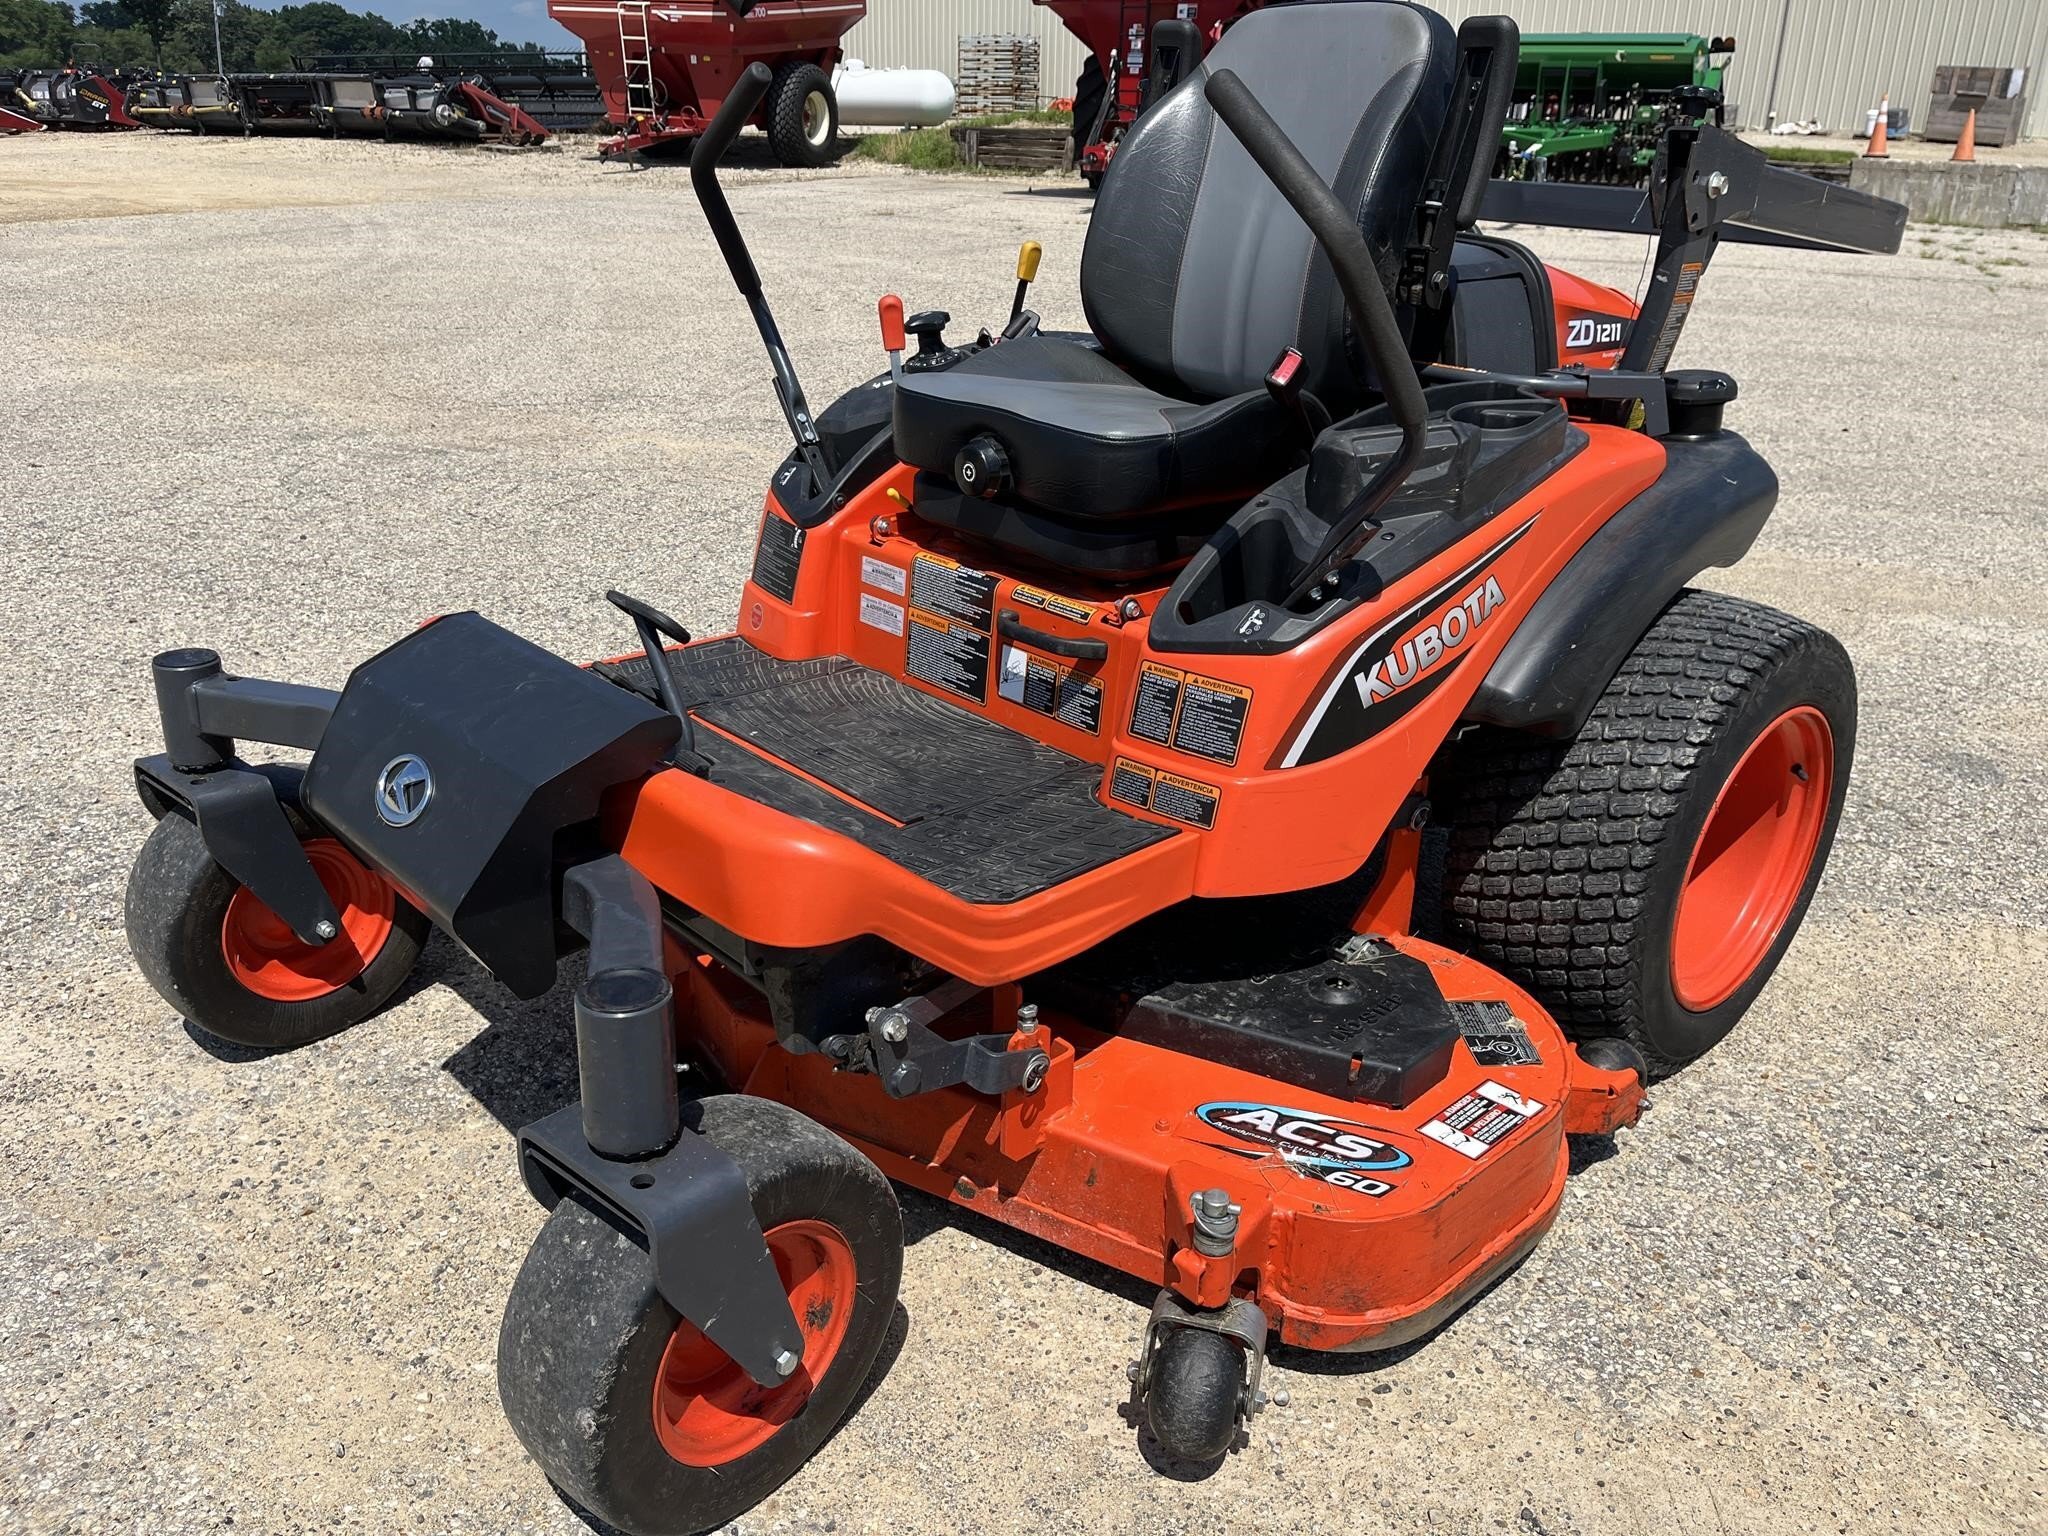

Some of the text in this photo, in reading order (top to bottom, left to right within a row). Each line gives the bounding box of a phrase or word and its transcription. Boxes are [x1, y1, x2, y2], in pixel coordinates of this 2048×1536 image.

[755, 8, 766, 17] 700
[79, 88, 109, 104] DRAGO
[91, 101, 107, 109] GT
[1566, 319, 1621, 347] ZD 1211
[916, 613, 945, 629] ADVERTENCIA
[1354, 575, 1505, 709] KUBOTA
[1153, 665, 1179, 678] WARNING
[1201, 679, 1243, 695] ADVERTENCIA
[1124, 761, 1151, 776] WARNING
[1167, 775, 1214, 795] ADVERTENCIA
[1446, 1094, 1475, 1113] DANGER
[1473, 1108, 1502, 1129] PELIGRO
[1212, 1121, 1276, 1144] Aerodynamic
[1279, 1141, 1319, 1157] Cutting
[1220, 1108, 1385, 1160] ACS
[1325, 1170, 1391, 1195] 60
